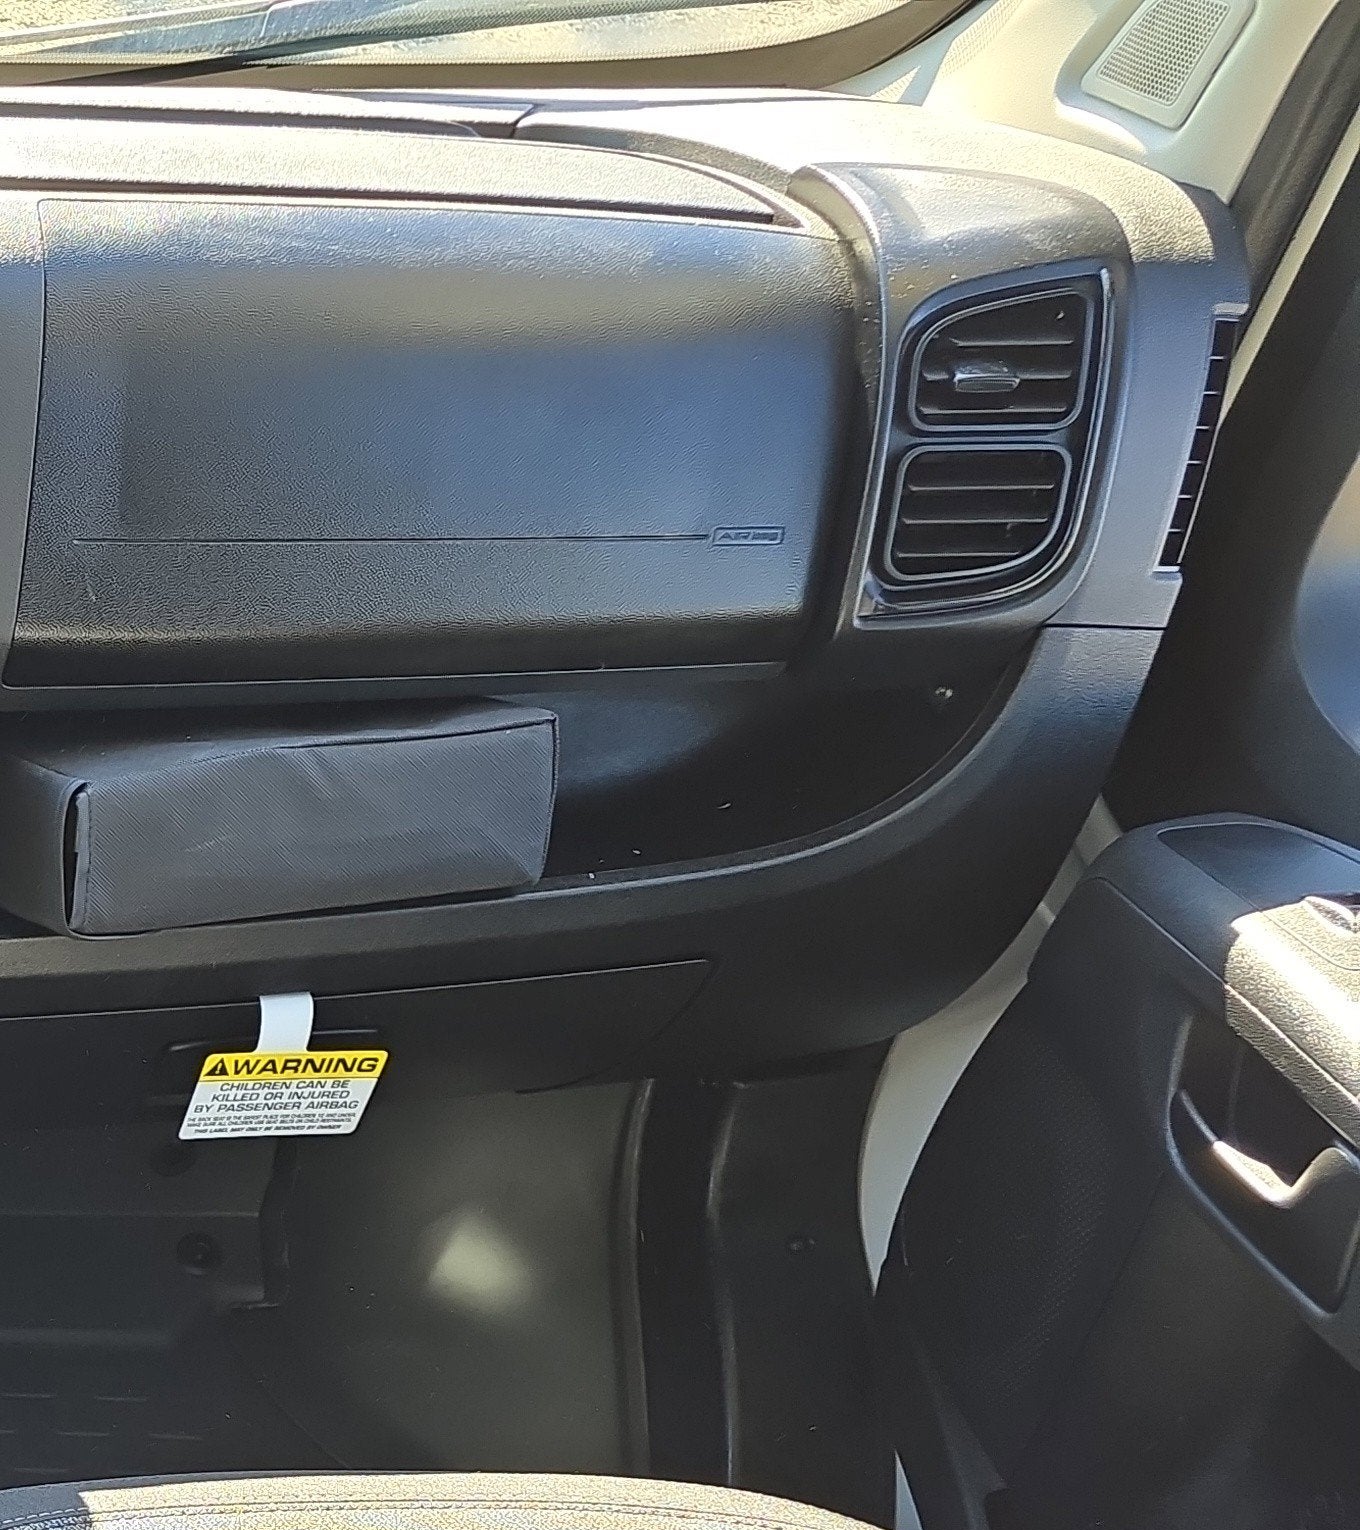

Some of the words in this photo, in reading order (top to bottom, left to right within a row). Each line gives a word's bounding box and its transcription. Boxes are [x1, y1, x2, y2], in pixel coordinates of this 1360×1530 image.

[233, 1057, 379, 1076] WARNING
[219, 1081, 293, 1092] CHILDREN
[296, 1080, 324, 1090] CAN
[330, 1080, 351, 1089] BE
[211, 1092, 261, 1103] KILLED
[263, 1092, 286, 1101] OR
[287, 1090, 351, 1100] INJURED
[194, 1104, 214, 1114] BY
[217, 1102, 302, 1113] PASSENGER
[305, 1100, 360, 1110] AIRBAG
